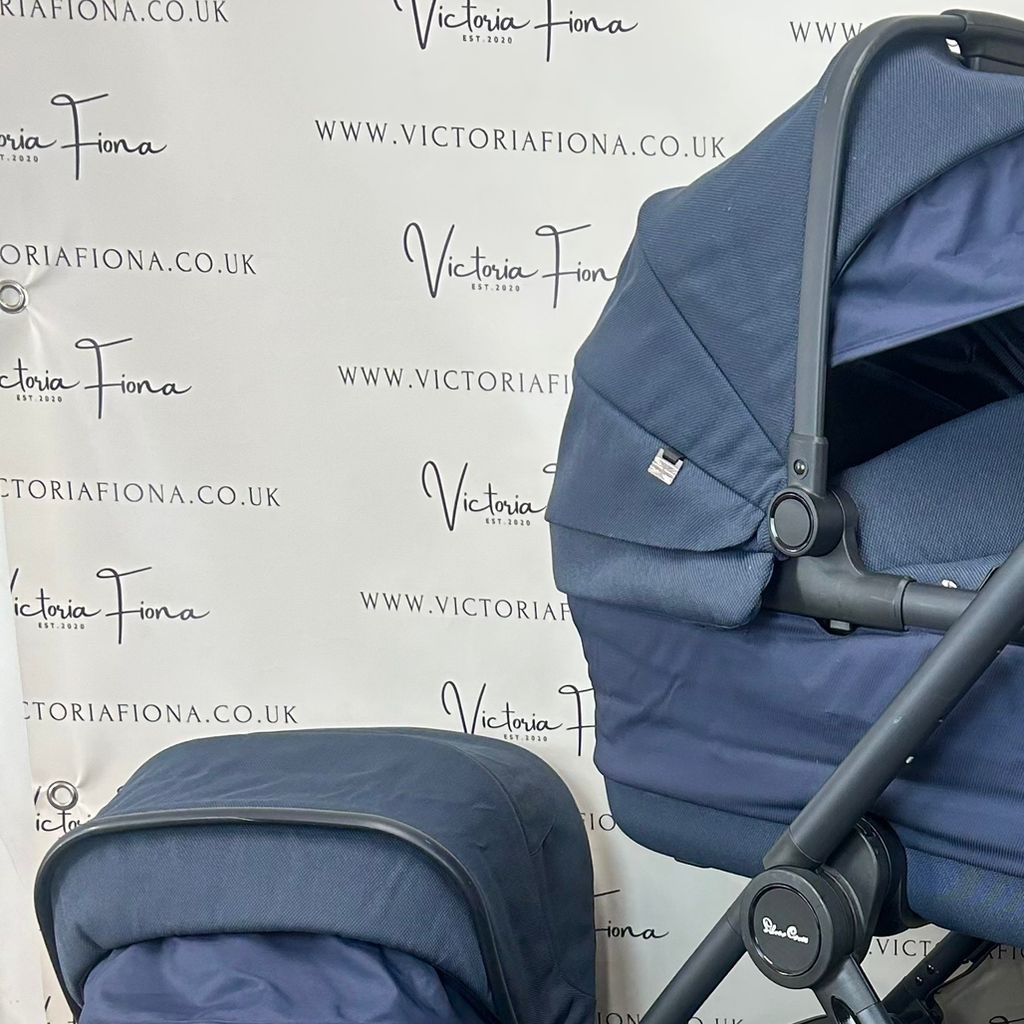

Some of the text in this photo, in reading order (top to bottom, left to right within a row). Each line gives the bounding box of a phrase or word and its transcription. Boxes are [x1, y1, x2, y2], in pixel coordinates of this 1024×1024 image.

[461, 34, 513, 44] EST.2020
[51, 93, 167, 181] Fiona
[314, 119, 726, 158] WWW.VICTORIAFIONA.CO.UK
[403, 222, 618, 309] Victoria Fion
[471, 283, 521, 292] EST.2020
[16, 394, 63, 403] EST.2020
[74, 337, 193, 419] Fiona
[421, 460, 548, 532] Victoria
[485, 517, 531, 526] EST.2020
[38, 621, 86, 630] EST.2020
[96, 566, 210, 645] Fiona
[441, 681, 563, 736] Victoria
